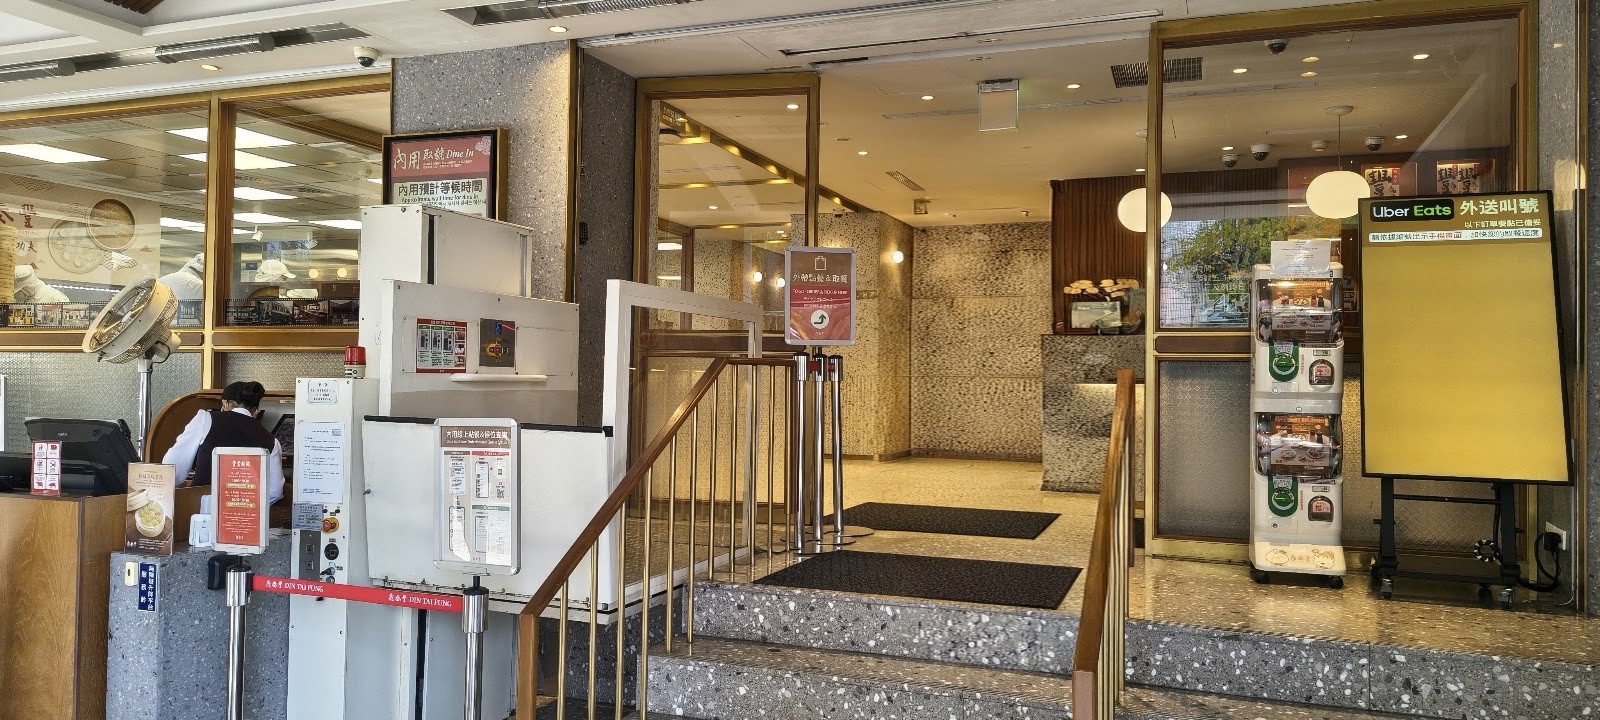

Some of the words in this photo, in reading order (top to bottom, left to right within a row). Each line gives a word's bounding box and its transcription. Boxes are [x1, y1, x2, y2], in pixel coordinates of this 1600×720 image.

[446, 150, 464, 159] Dine
[465, 149, 474, 157] In
[398, 180, 483, 196] 內用預計等候時間
[1372, 206, 1410, 218] Uber
[1413, 205, 1452, 216] Eats
[1459, 198, 1540, 216] 外送叫號
[1464, 218, 1542, 228] 以下訂單餐點已備妥
[284, 582, 297, 590] DIN
[297, 583, 307, 591] TAI
[307, 584, 324, 593] FUNG
[409, 596, 422, 604] DIN
[422, 597, 433, 605] TAI
[433, 598, 452, 607] FUNG
